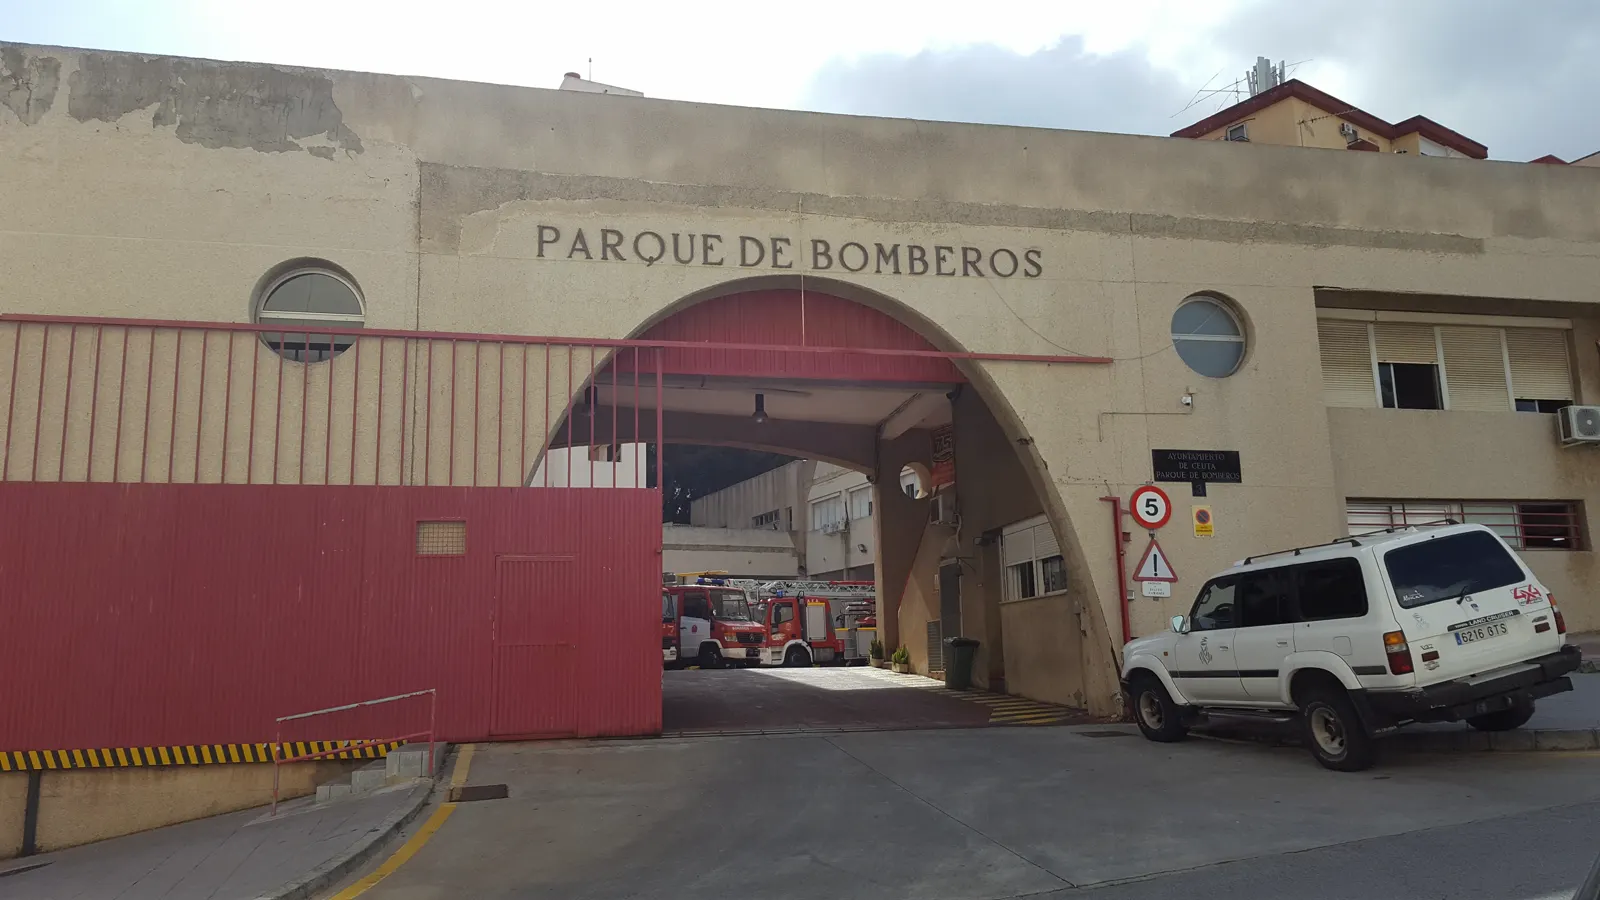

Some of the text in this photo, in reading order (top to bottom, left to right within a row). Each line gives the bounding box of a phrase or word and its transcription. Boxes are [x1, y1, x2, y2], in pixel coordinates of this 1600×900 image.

[536, 224, 1043, 279] PARQUE DE BOMBEROS
[1167, 452, 1225, 461] AYUNTAMIENTO
[1179, 462, 1216, 470] DE CEUTA
[1156, 471, 1186, 479] PARQUE
[1202, 472, 1240, 480] BOMBEROS
[1145, 498, 1159, 516] 5
[1469, 617, 1487, 626] LAND
[1486, 610, 1514, 622] CRUISER
[1461, 623, 1507, 643] 6216 GTS
